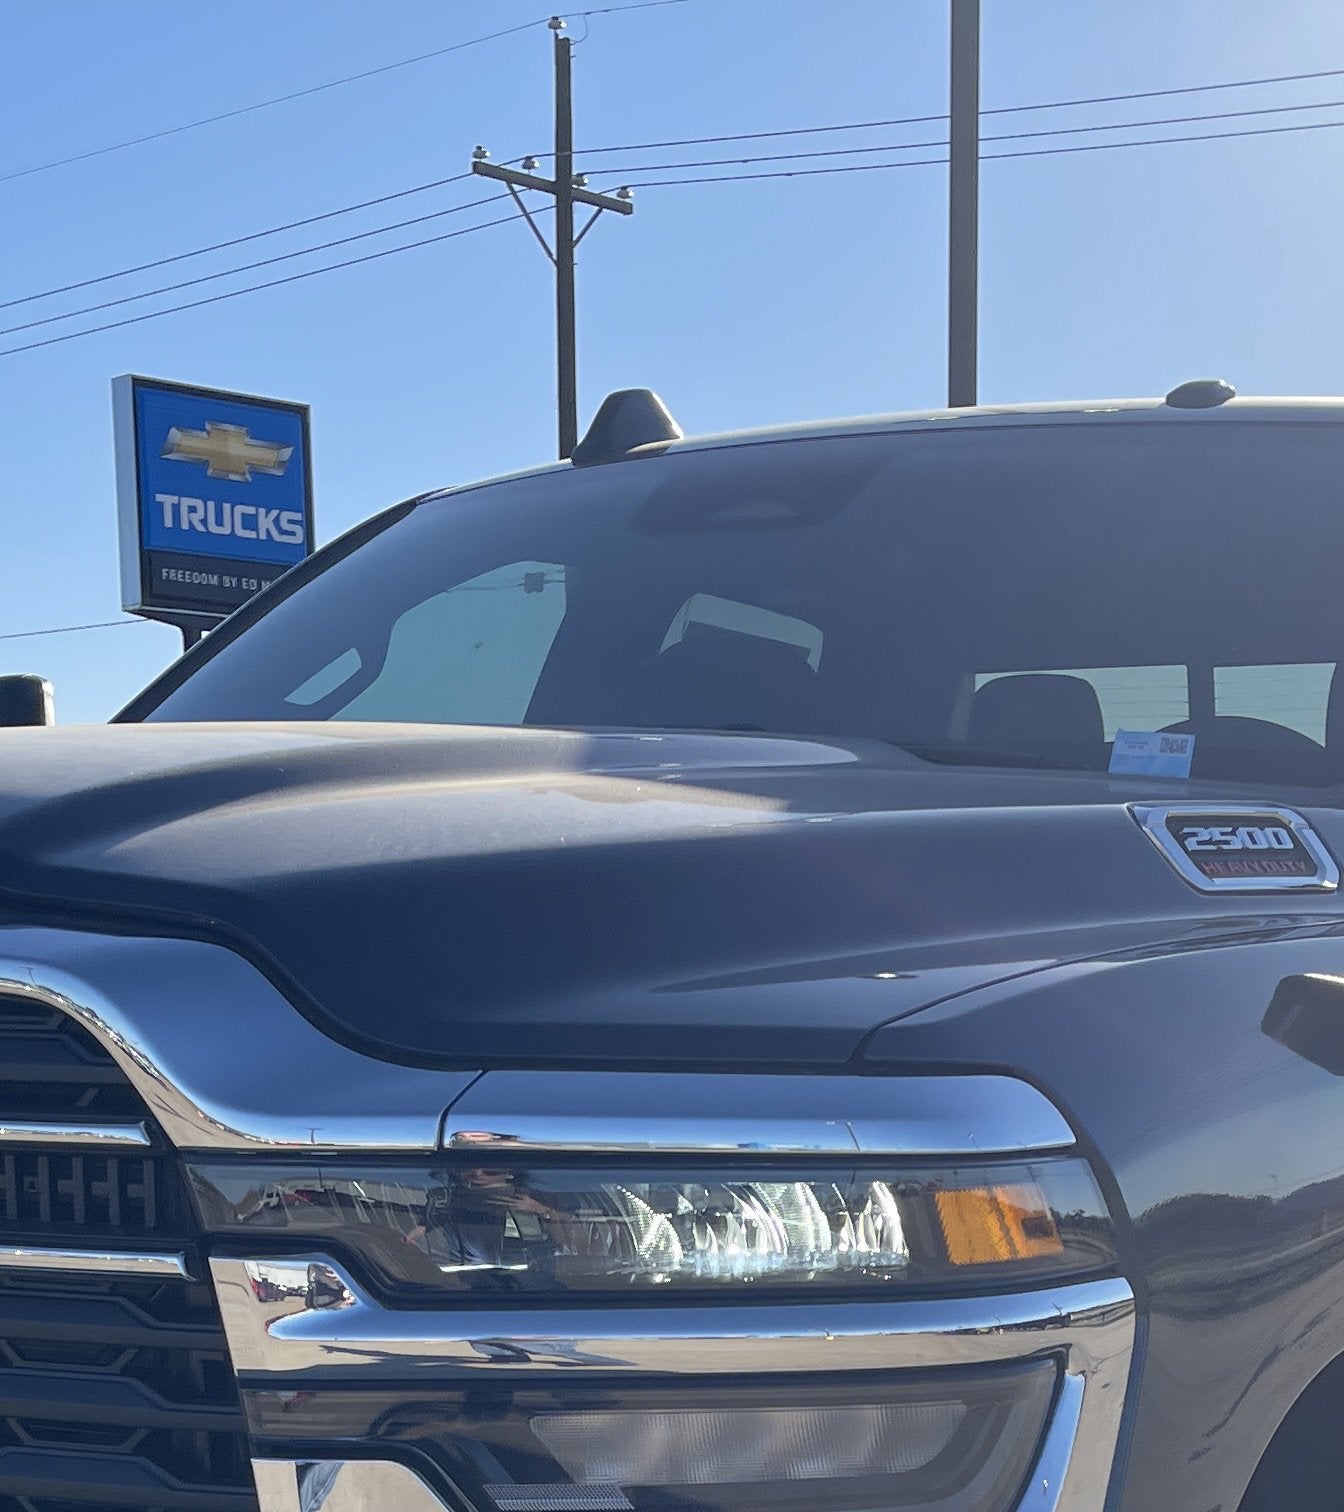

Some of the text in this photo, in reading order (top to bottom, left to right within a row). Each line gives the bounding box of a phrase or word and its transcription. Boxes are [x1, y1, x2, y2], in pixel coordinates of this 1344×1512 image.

[154, 493, 305, 545] TRUCKS
[161, 568, 219, 586] FREEDOM
[222, 575, 238, 588] BY
[241, 577, 257, 591] ED
[1179, 826, 1295, 851] 2500
[1201, 861, 1306, 875] HEAVY DUTY
